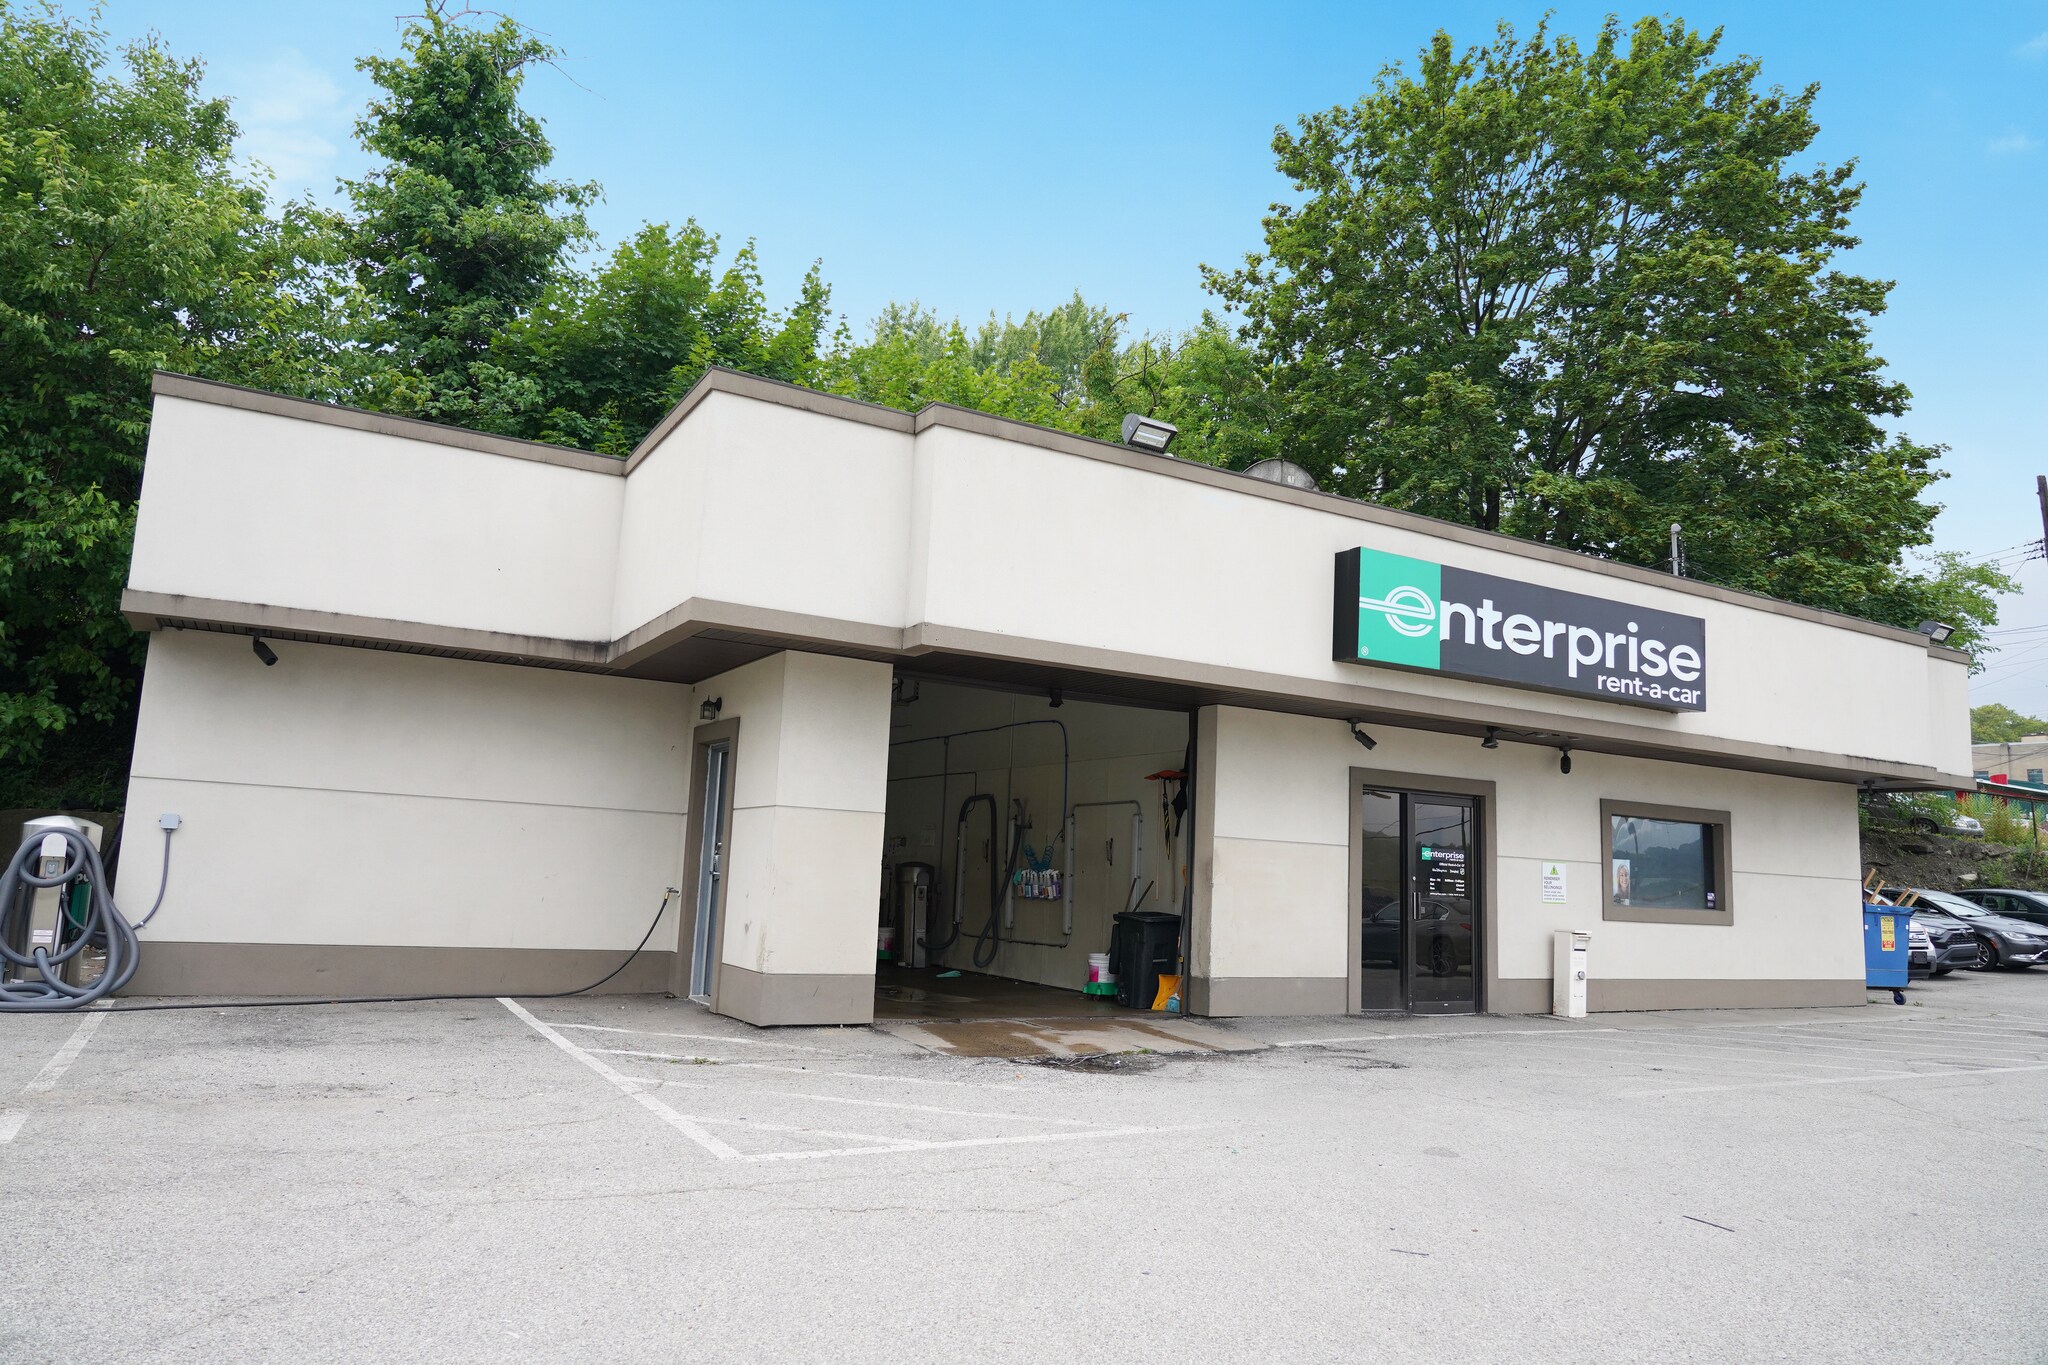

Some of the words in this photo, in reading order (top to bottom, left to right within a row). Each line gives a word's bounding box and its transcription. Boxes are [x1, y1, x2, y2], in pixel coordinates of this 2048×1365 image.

[1361, 585, 1701, 682] enterprise
[1597, 674, 1701, 705] rent-a-car
[1423, 850, 1465, 860] enterprise
